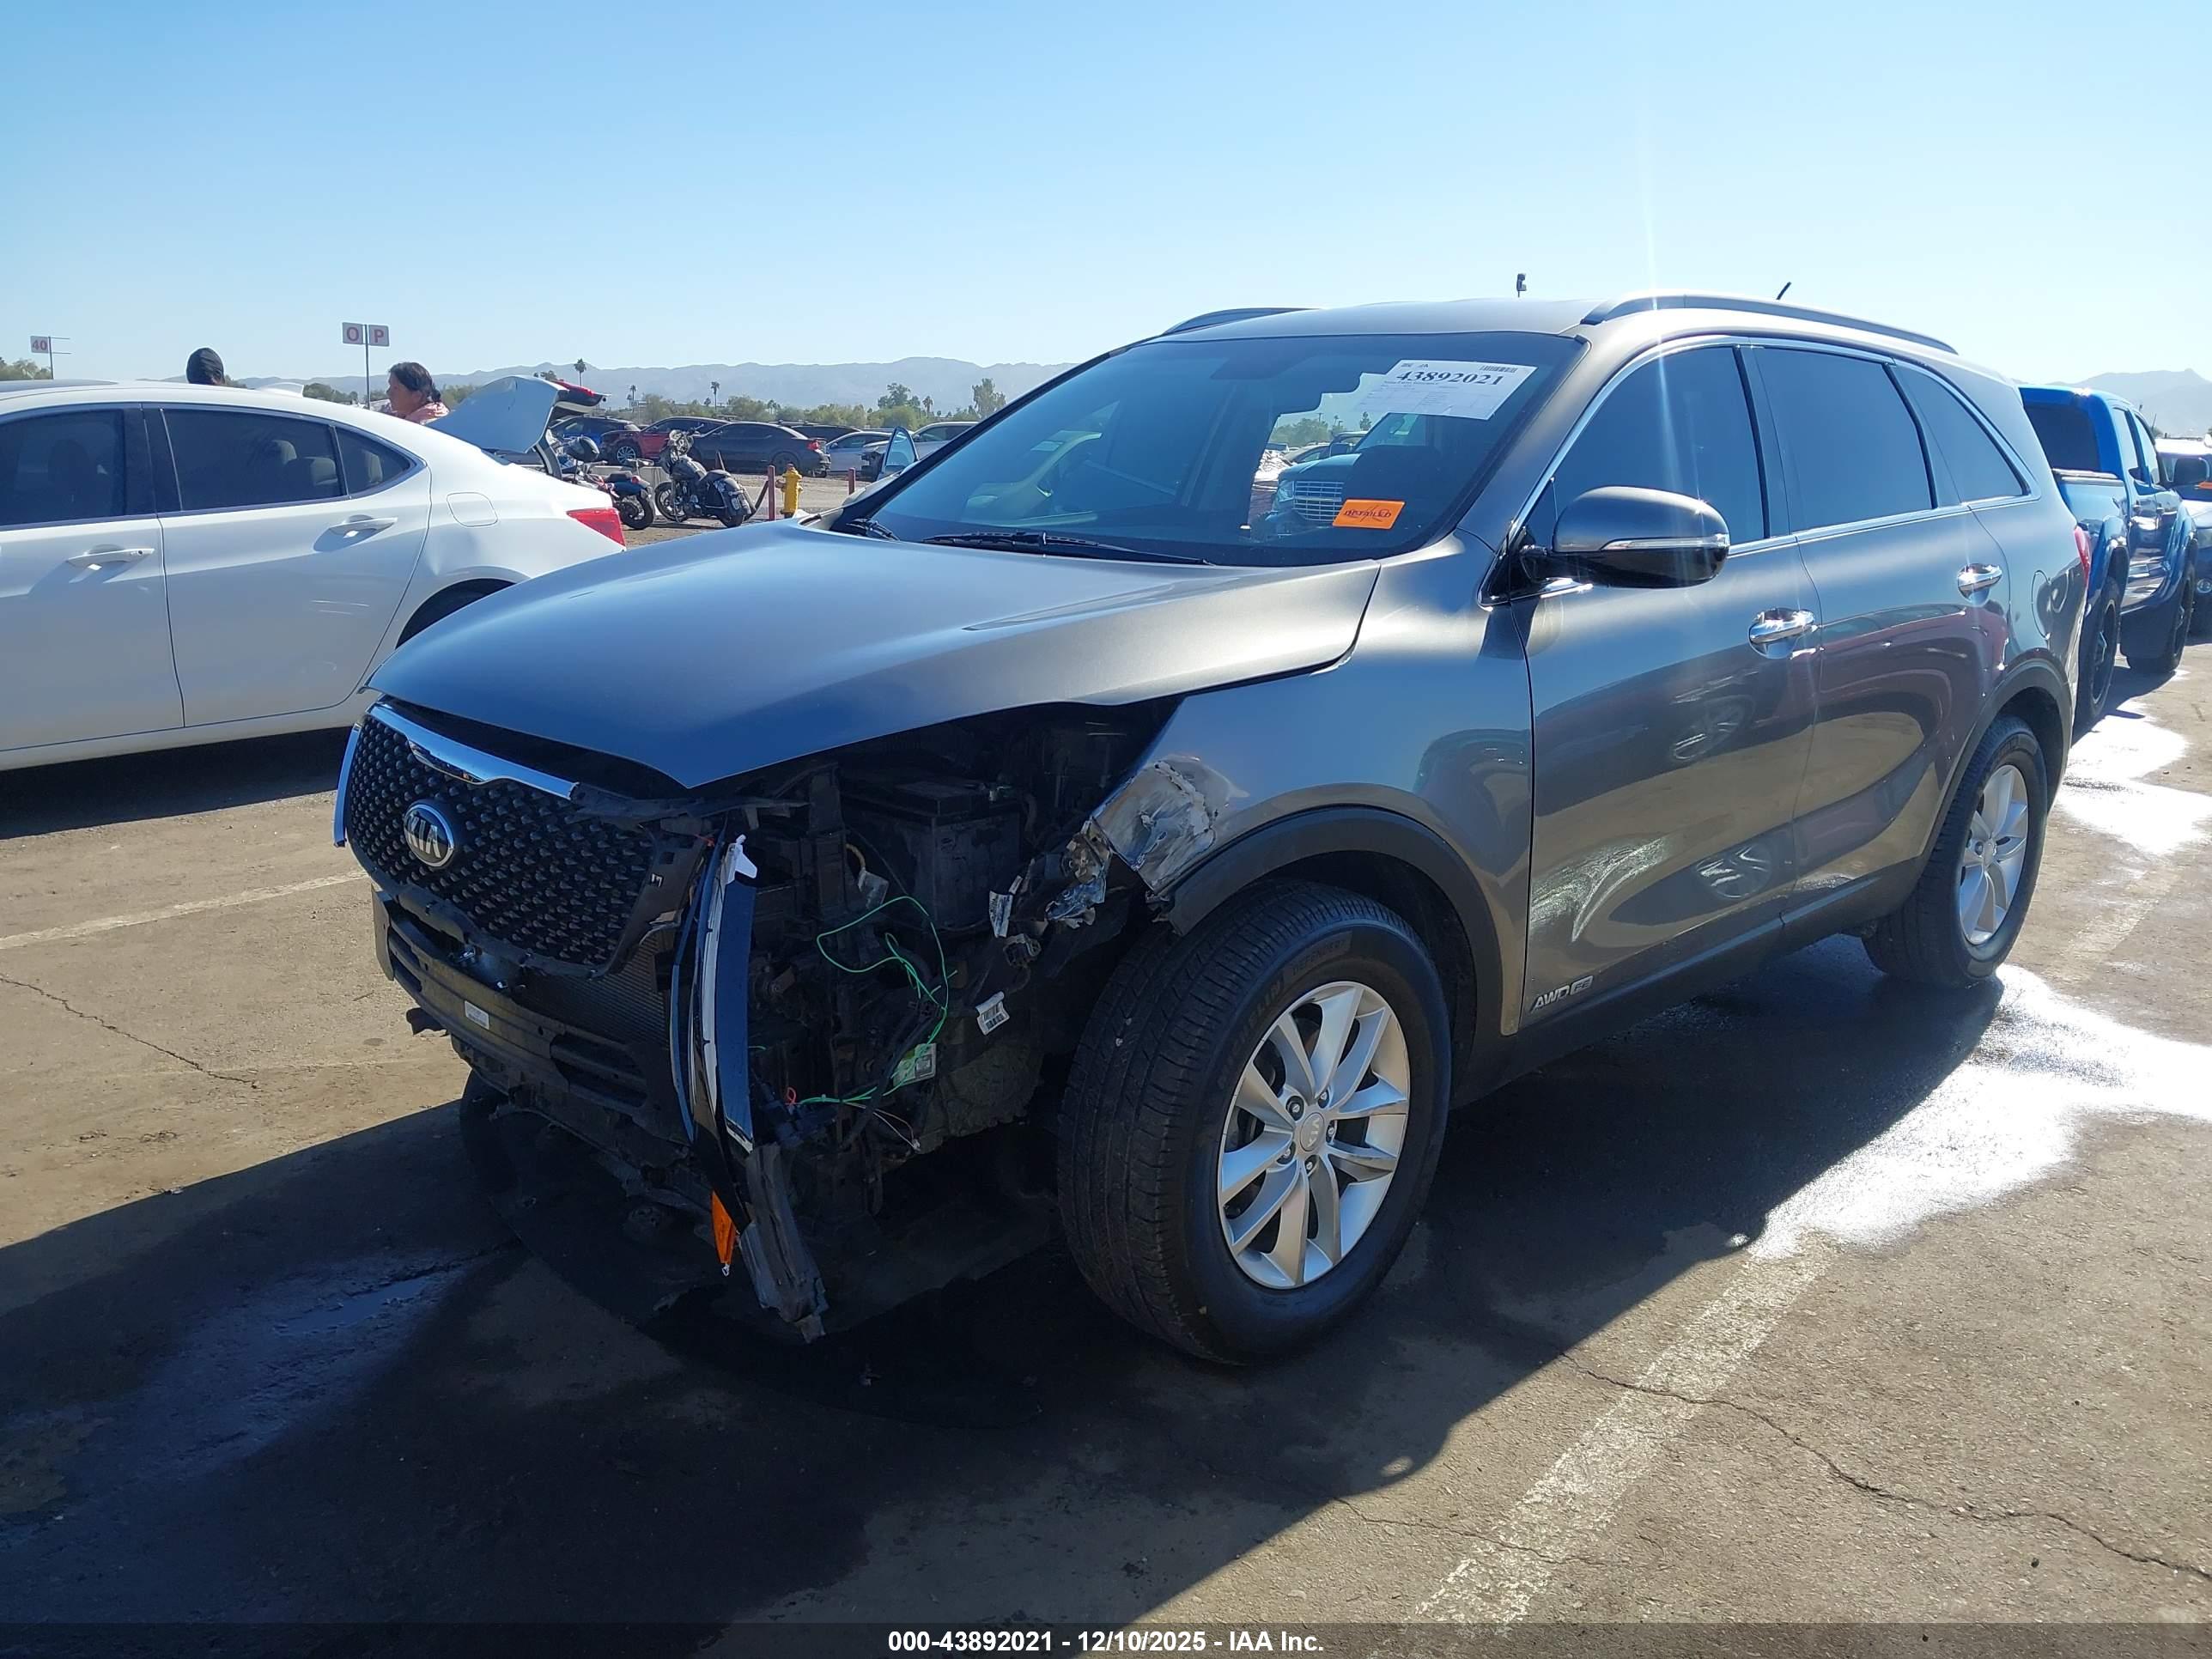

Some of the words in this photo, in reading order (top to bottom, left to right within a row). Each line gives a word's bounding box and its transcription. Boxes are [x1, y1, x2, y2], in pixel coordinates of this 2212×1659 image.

[346, 326, 360, 343] O
[374, 329, 385, 343] P
[32, 338, 49, 352] 40
[1395, 370, 1504, 386] 43892021
[407, 811, 442, 859] KIA
[1530, 984, 1571, 1015] AWD
